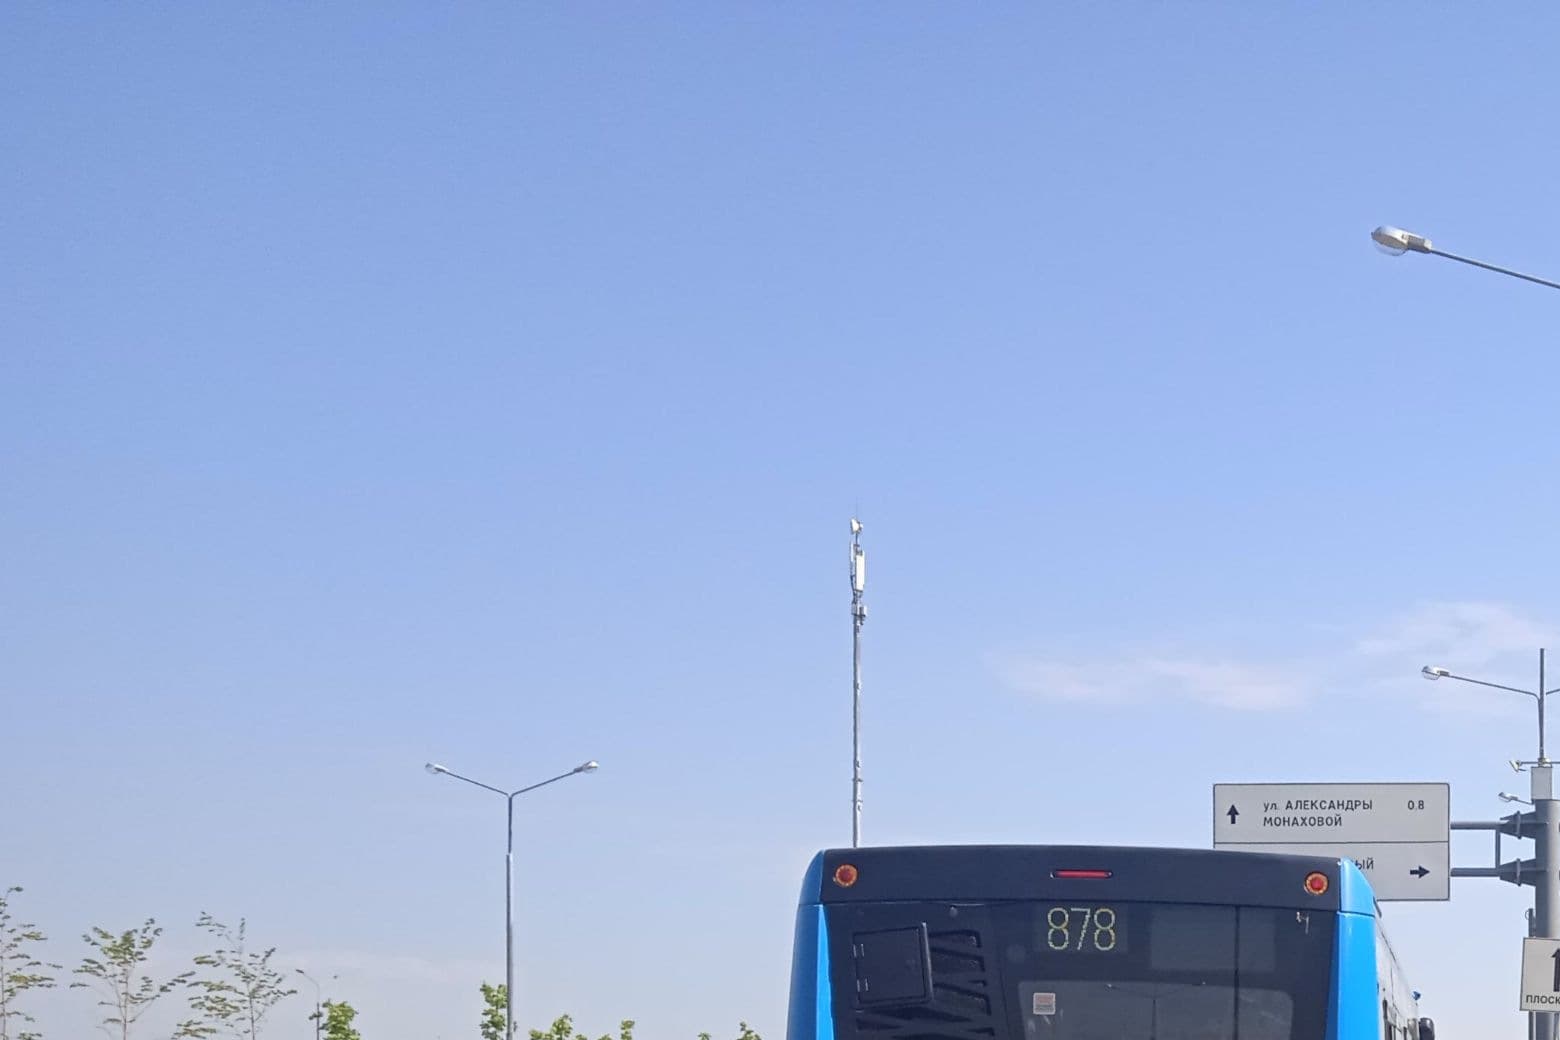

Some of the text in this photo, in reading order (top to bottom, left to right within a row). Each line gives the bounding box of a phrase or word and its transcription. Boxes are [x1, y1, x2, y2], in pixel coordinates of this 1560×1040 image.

[1285, 800, 1373, 811] АЛЕКСАНДРЫ
[1263, 814, 1343, 827] МОНАХОВОЙ
[1047, 907, 1116, 951] 878
